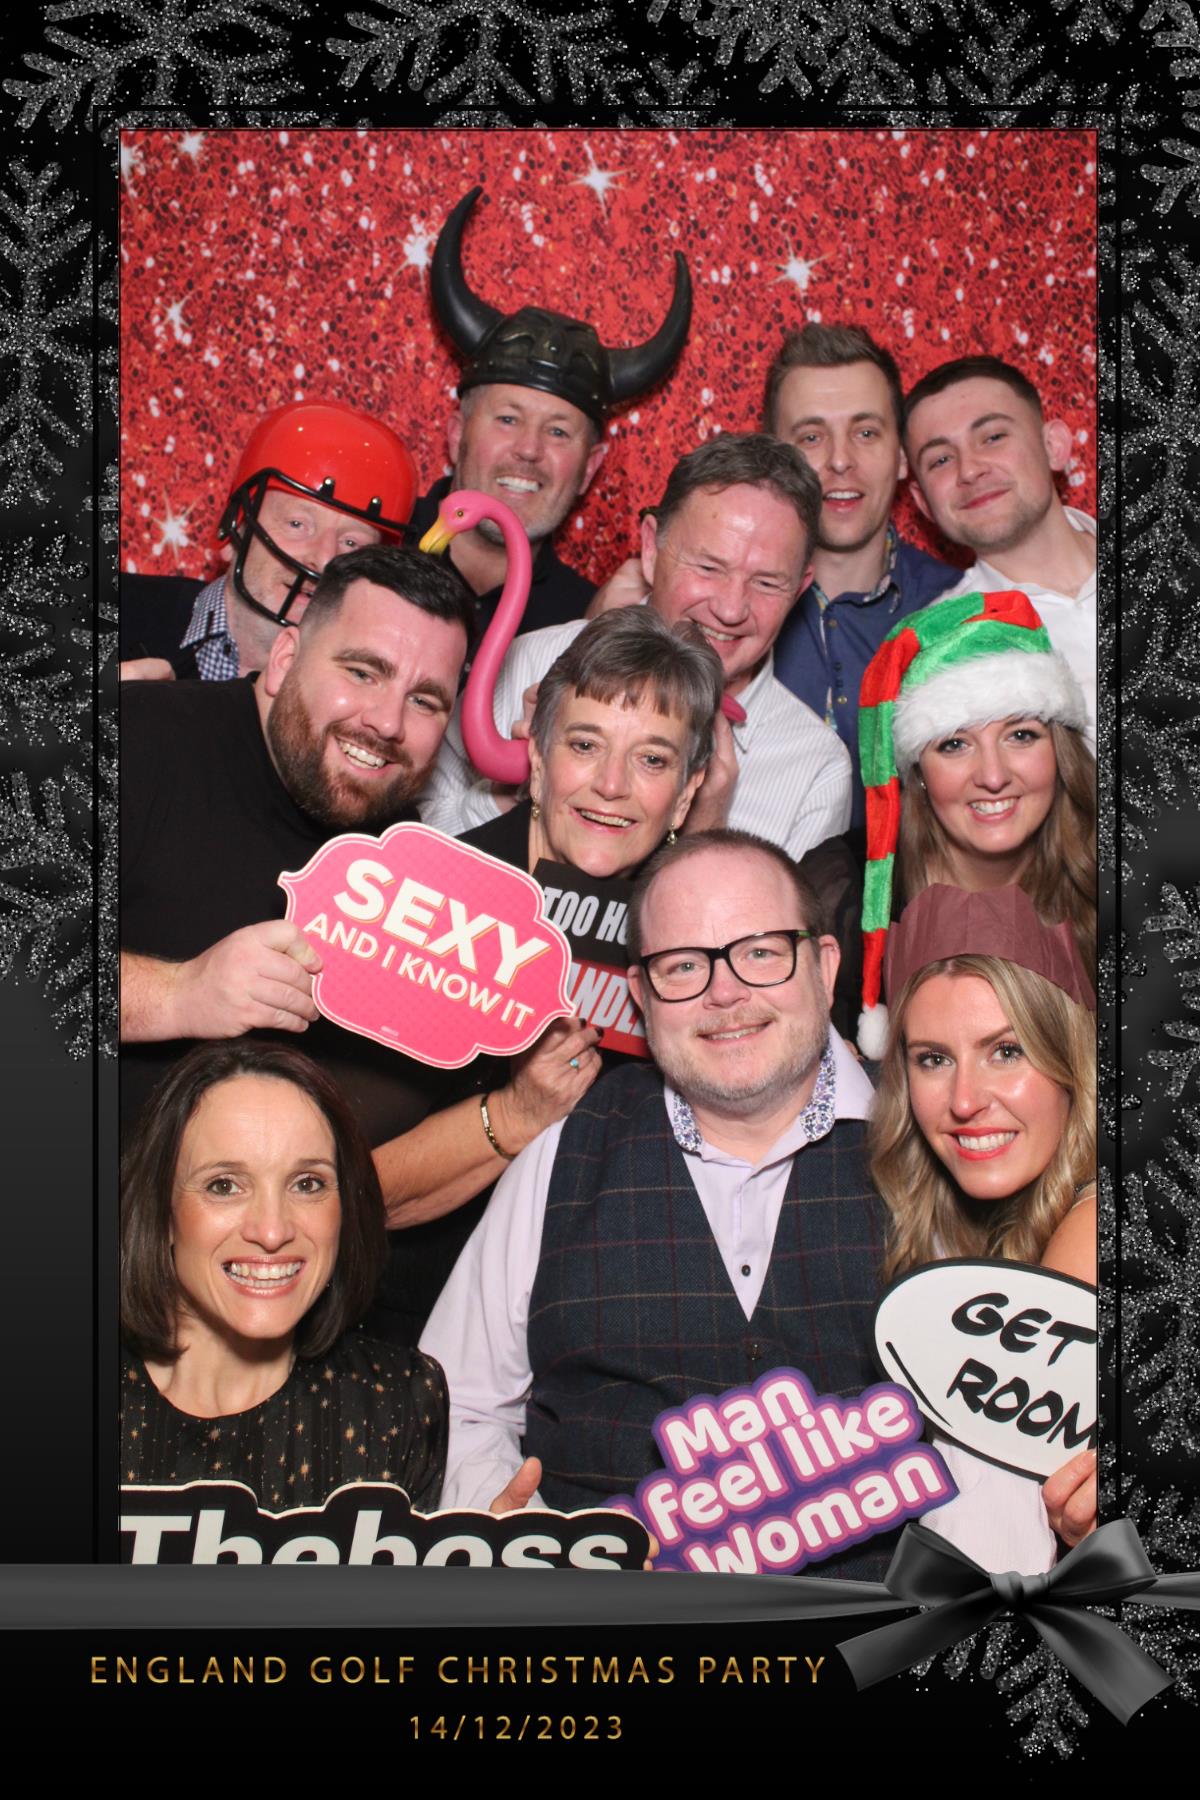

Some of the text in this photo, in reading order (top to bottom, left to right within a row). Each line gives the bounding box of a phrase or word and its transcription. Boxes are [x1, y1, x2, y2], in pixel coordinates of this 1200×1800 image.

[333, 859, 551, 988] SEXY
[544, 886, 600, 937] TOO
[303, 912, 536, 1030] AND I KNOW IT
[951, 1292, 1098, 1367] GET
[665, 1380, 808, 1471] Man
[946, 1358, 1098, 1450] ROOM
[647, 1396, 910, 1540] feel like
